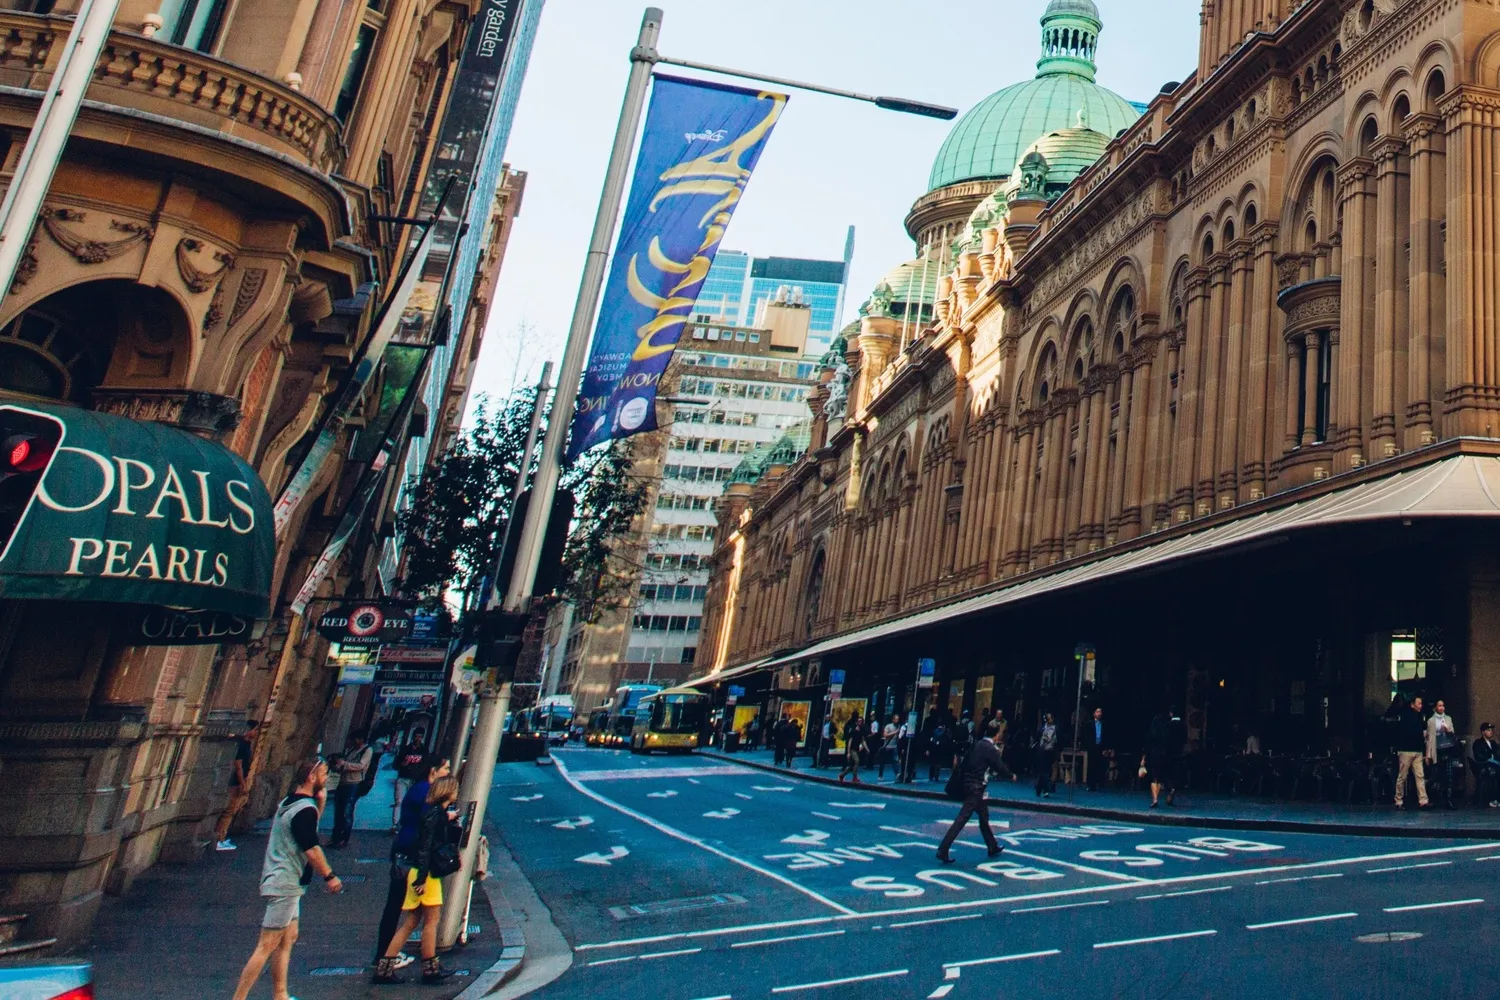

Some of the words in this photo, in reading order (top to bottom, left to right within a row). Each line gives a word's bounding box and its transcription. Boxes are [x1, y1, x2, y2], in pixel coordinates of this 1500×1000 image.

[479, 8, 505, 58] garden
[37, 446, 255, 534] OPALS
[65, 537, 229, 587] PEARLS
[321, 617, 348, 627] RED
[383, 619, 408, 629] EYE
[763, 842, 956, 870] LANE
[1080, 836, 1285, 867] BUS
[852, 861, 1065, 897] BUS
